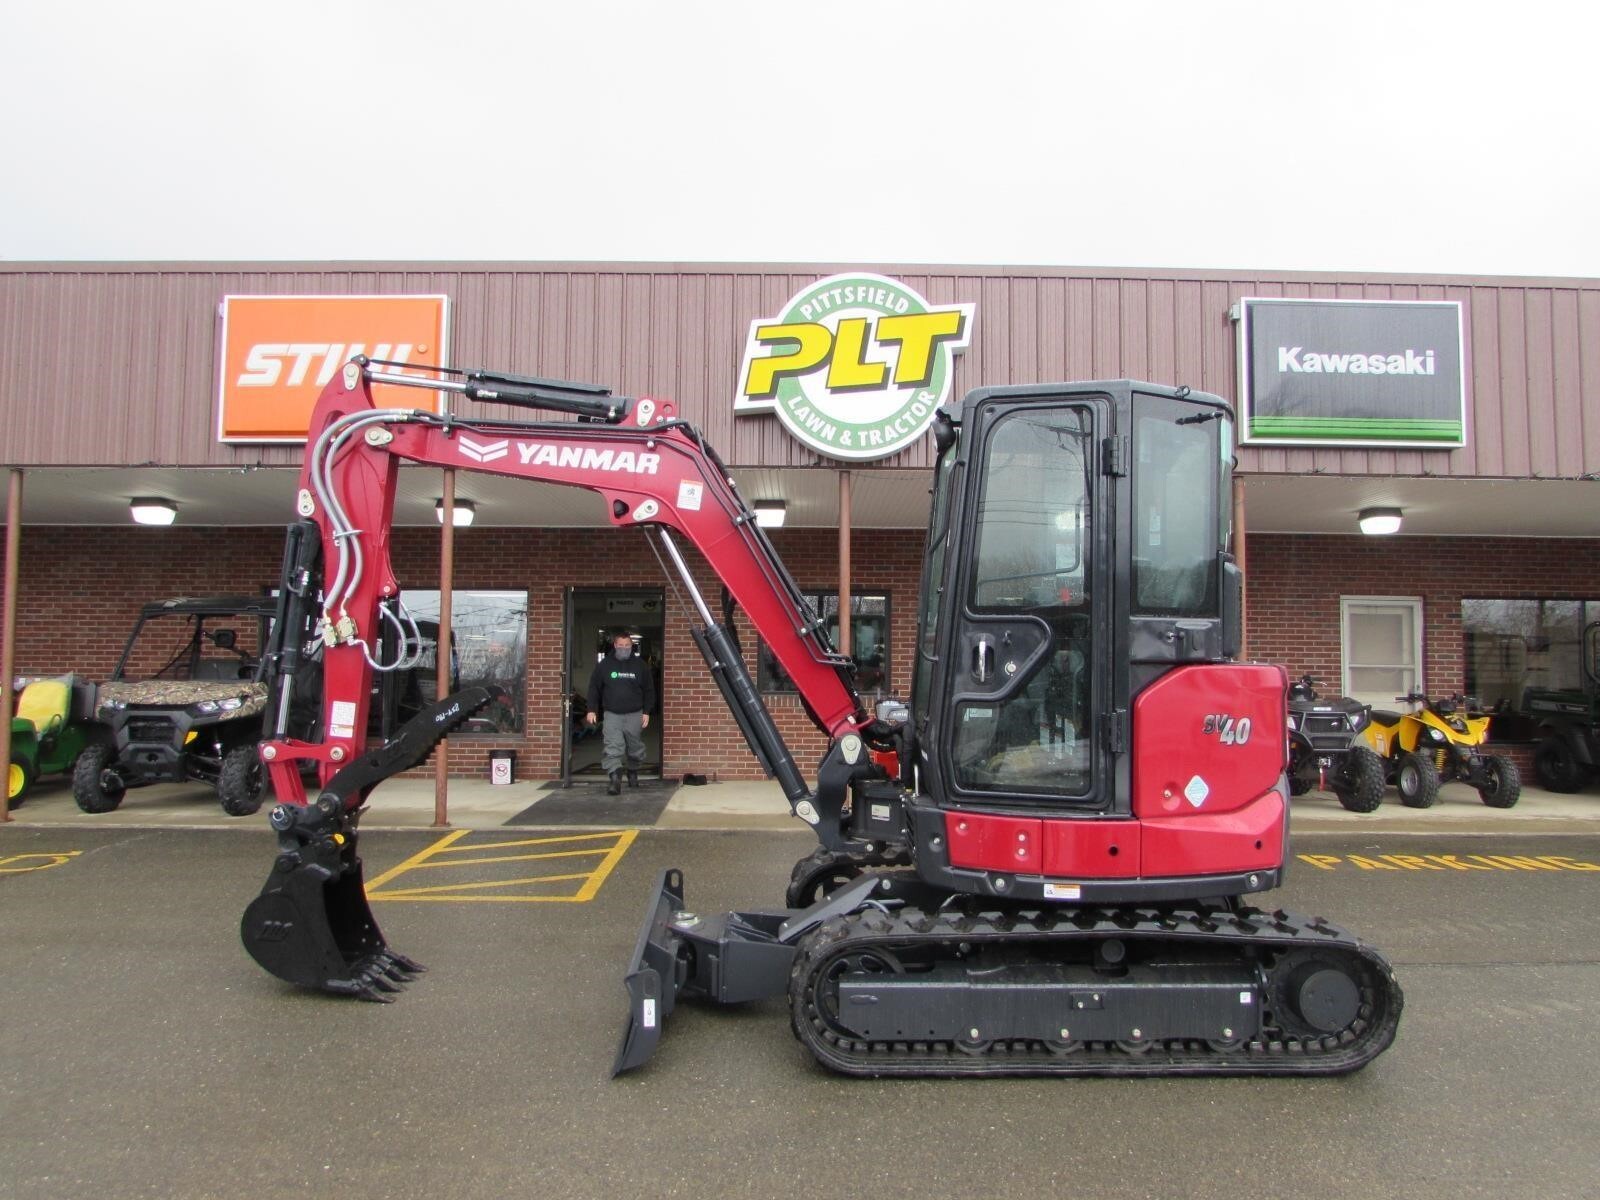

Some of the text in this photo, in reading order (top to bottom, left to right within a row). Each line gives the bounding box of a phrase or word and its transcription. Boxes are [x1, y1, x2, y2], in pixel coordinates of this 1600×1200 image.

[799, 285, 910, 321] PITTSFIELD
[744, 310, 963, 397] PLT
[1277, 346, 1435, 375] Kawasaki
[787, 390, 936, 447] LAWN & TRACTOR
[516, 442, 661, 475] YANMAR
[1296, 854, 1600, 871] PARKING
